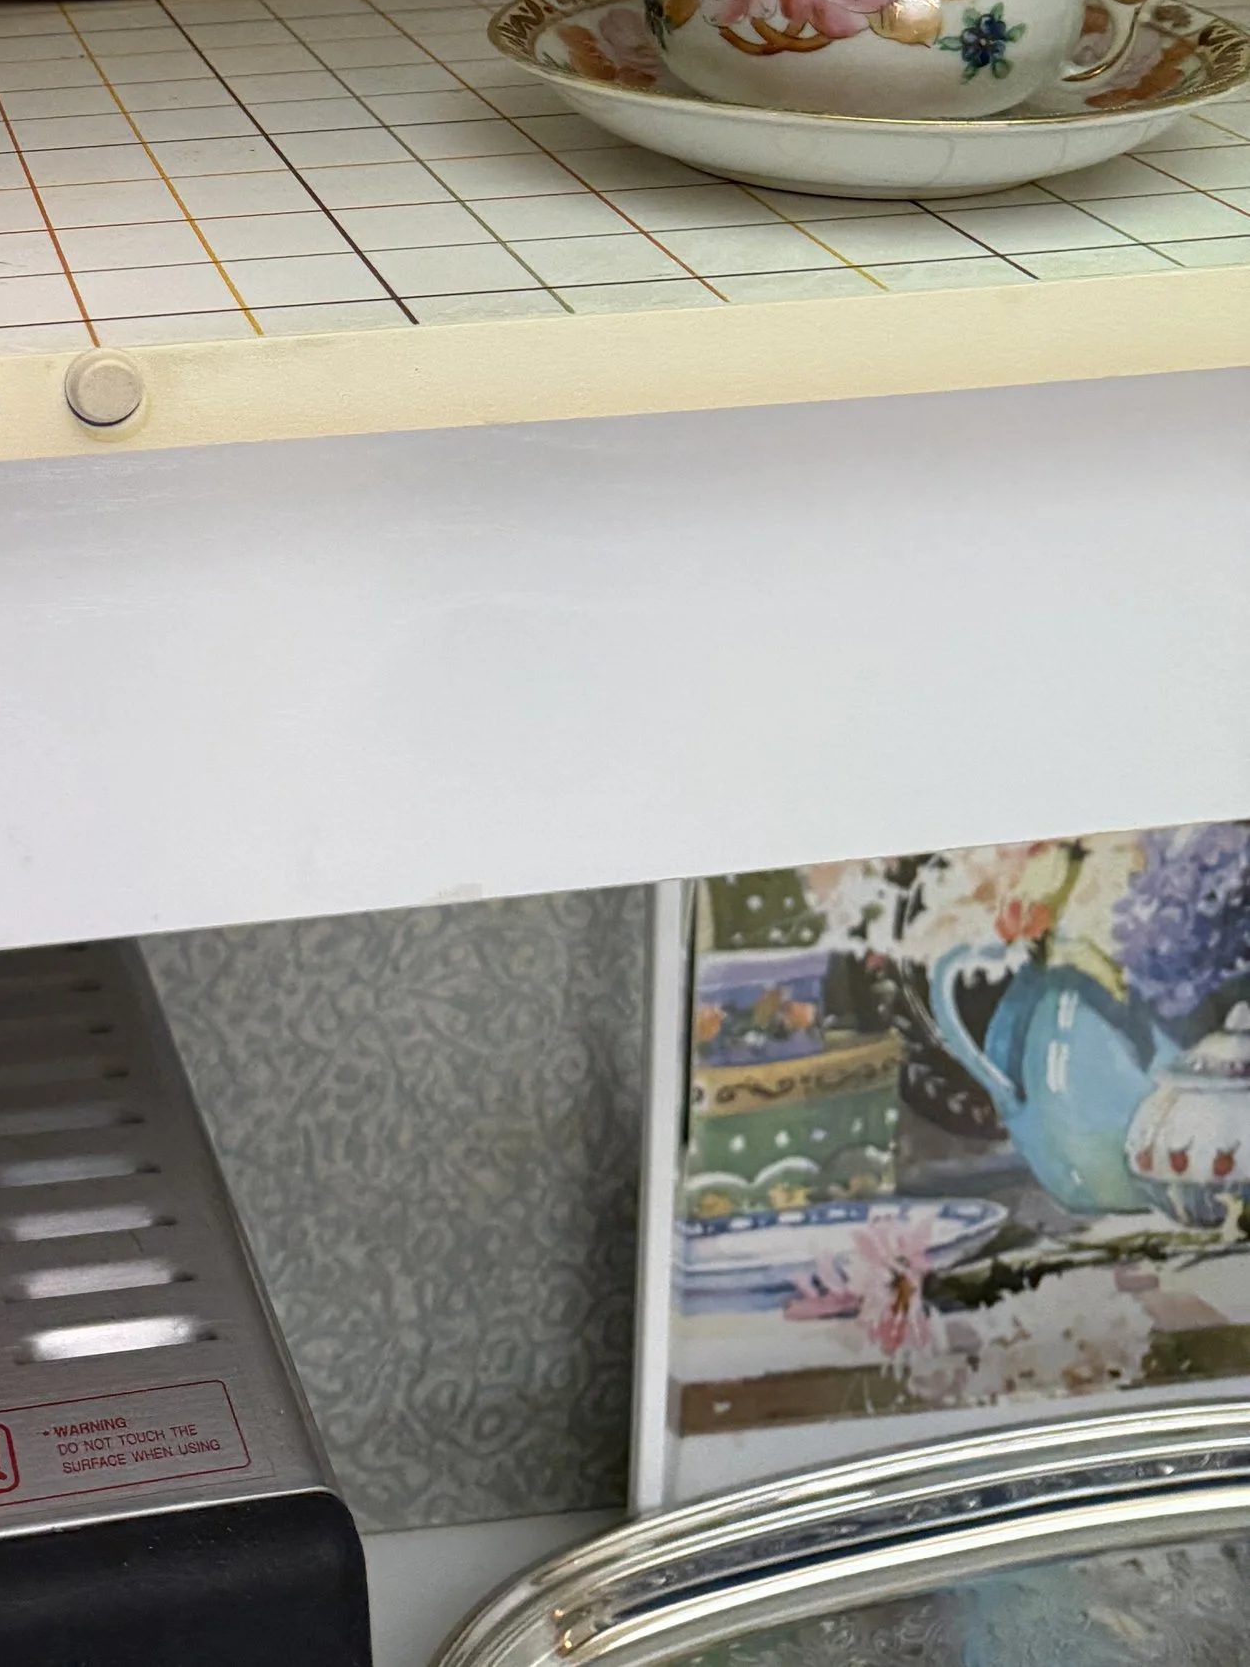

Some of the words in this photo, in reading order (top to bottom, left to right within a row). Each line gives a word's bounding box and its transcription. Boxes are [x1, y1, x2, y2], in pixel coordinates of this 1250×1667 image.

[53, 1417, 127, 1438] WARNING
[57, 1441, 78, 1456] DO
[84, 1437, 111, 1451] NOT
[119, 1430, 166, 1446] TOUCH
[170, 1424, 198, 1438] THE
[62, 1453, 127, 1474] SURFACE
[132, 1445, 174, 1463] WHEN
[178, 1439, 221, 1455] USING
